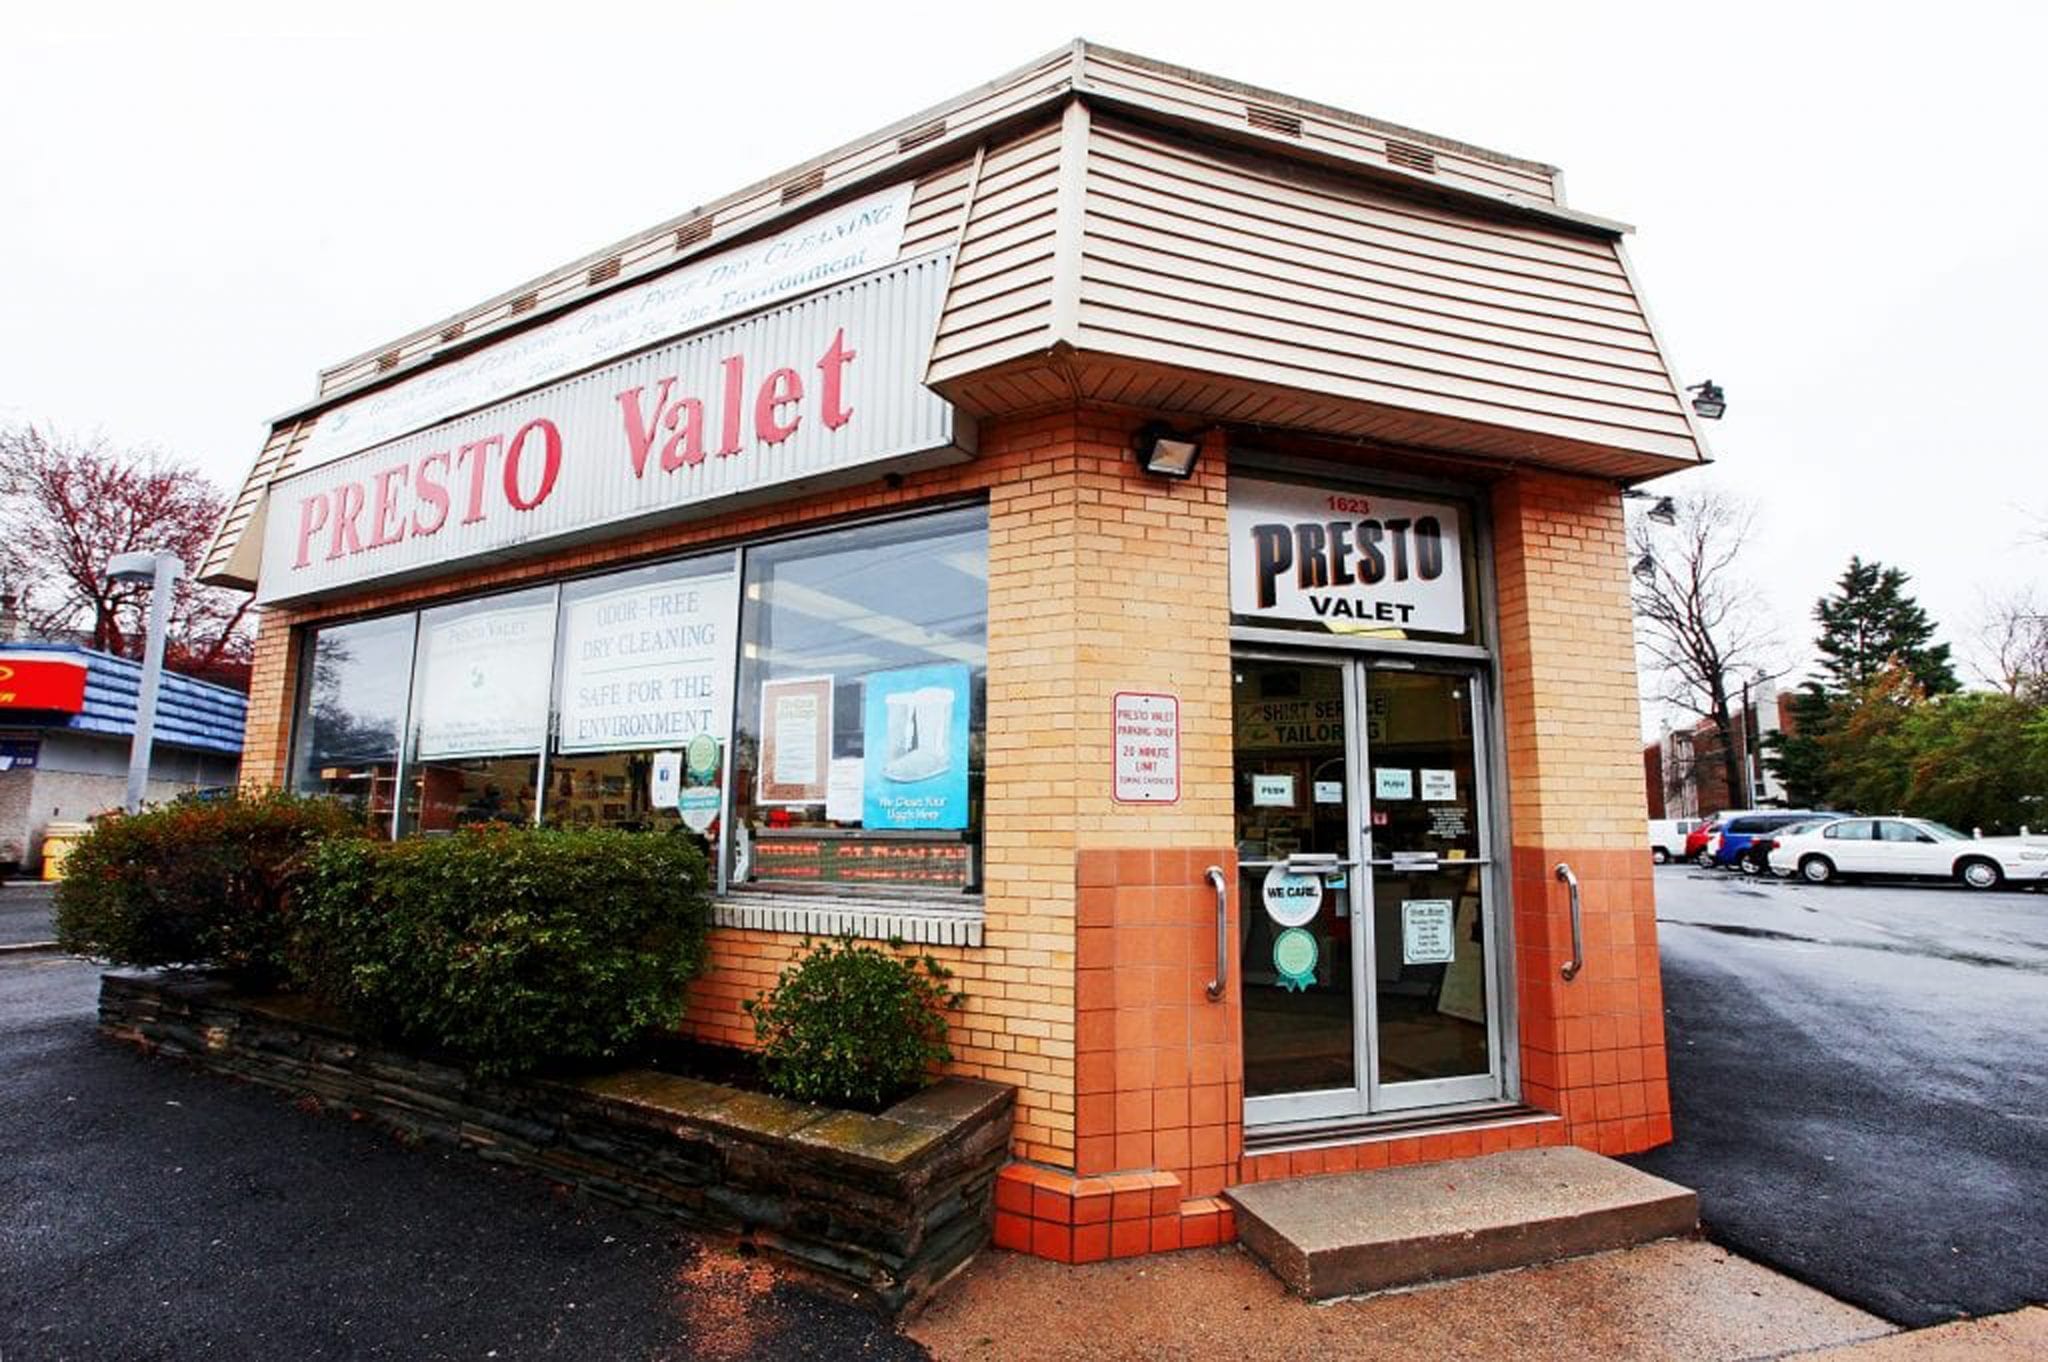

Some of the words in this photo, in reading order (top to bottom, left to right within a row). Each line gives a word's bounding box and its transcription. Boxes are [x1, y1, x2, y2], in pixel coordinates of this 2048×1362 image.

[764, 203, 893, 265] CLEANING
[719, 249, 866, 313] Environment
[290, 416, 563, 571] PRESTO
[614, 326, 857, 480] Valet
[1328, 495, 1370, 515] 1623
[1250, 515, 1444, 610] PRESTO
[597, 591, 700, 627] ODOR-FREE
[1309, 595, 1415, 623] VALET
[581, 638, 612, 660] DRY
[617, 622, 716, 656] CLEANING
[578, 683, 622, 709] SAFE
[627, 679, 663, 704] FOR
[671, 674, 714, 700] THE
[578, 709, 713, 740] ENVIRONMENT
[1117, 708, 1149, 721] PRESTO
[1263, 702, 1311, 721] SHIRT
[1267, 887, 1285, 898] WE
